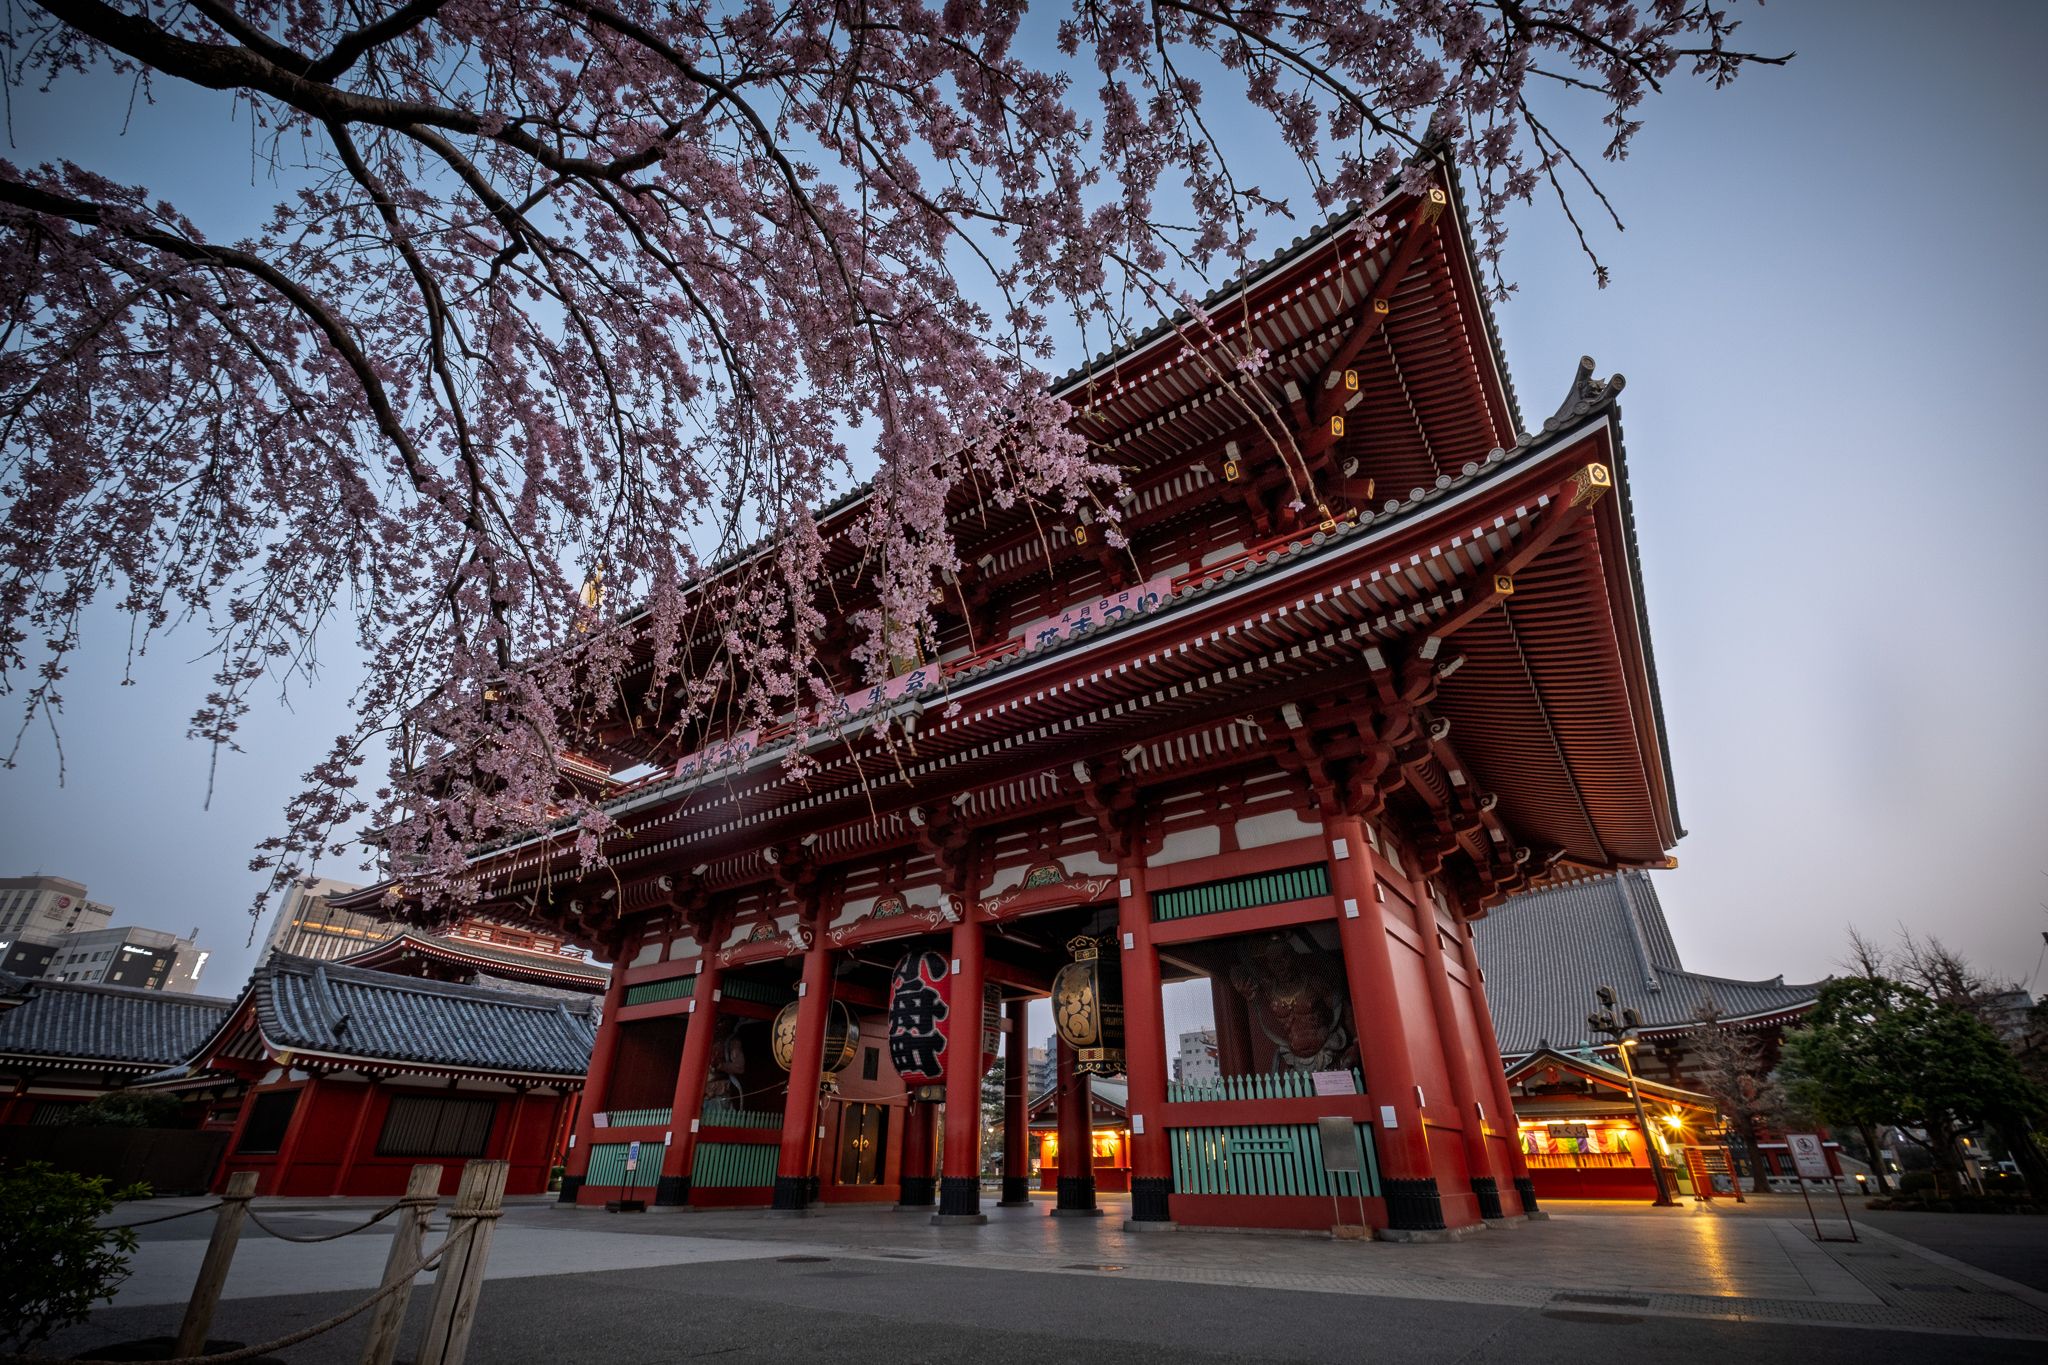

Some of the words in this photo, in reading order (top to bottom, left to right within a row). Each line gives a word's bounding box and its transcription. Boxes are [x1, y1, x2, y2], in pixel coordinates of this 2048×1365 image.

[1036, 592, 1159, 647] 花まつり
[1062, 592, 1129, 624] 4月8日
[888, 950, 950, 1079] 小舟町
[1552, 1126, 1586, 1137] みくじ
